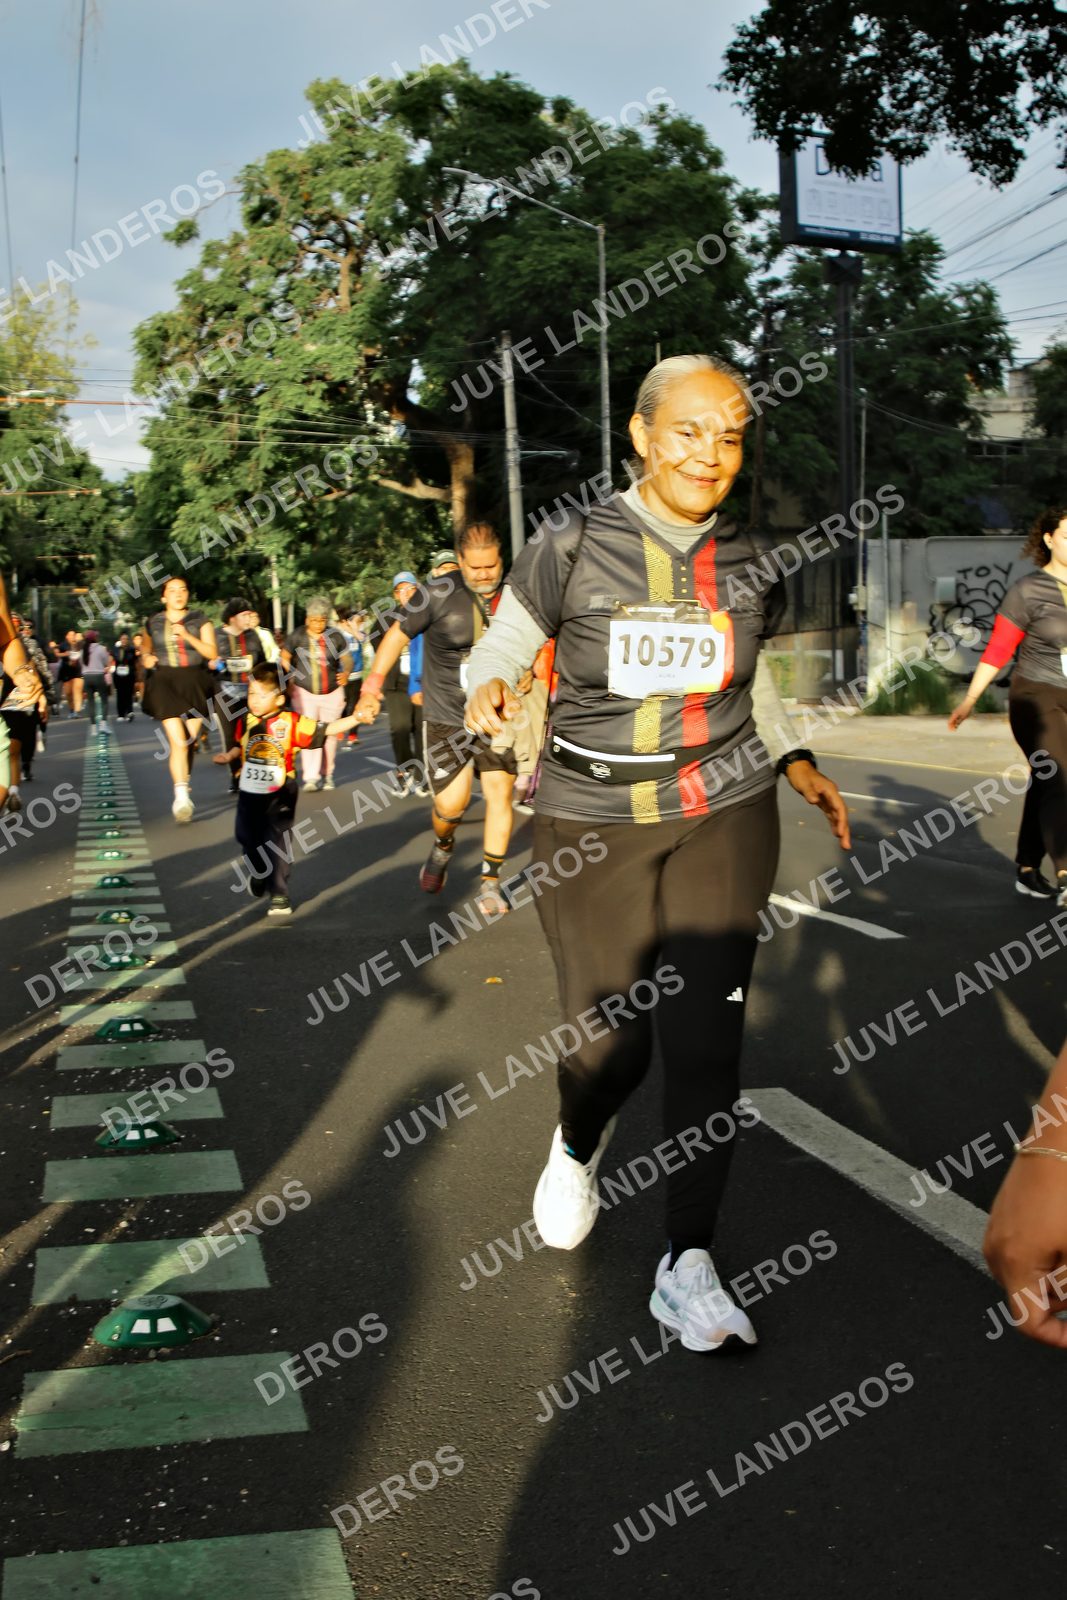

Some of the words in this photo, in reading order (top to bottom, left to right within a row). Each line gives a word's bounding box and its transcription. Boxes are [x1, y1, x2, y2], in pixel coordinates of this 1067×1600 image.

[957, 562, 1013, 583] TOY
[618, 633, 716, 668] 10579
[246, 768, 274, 781] 5325
